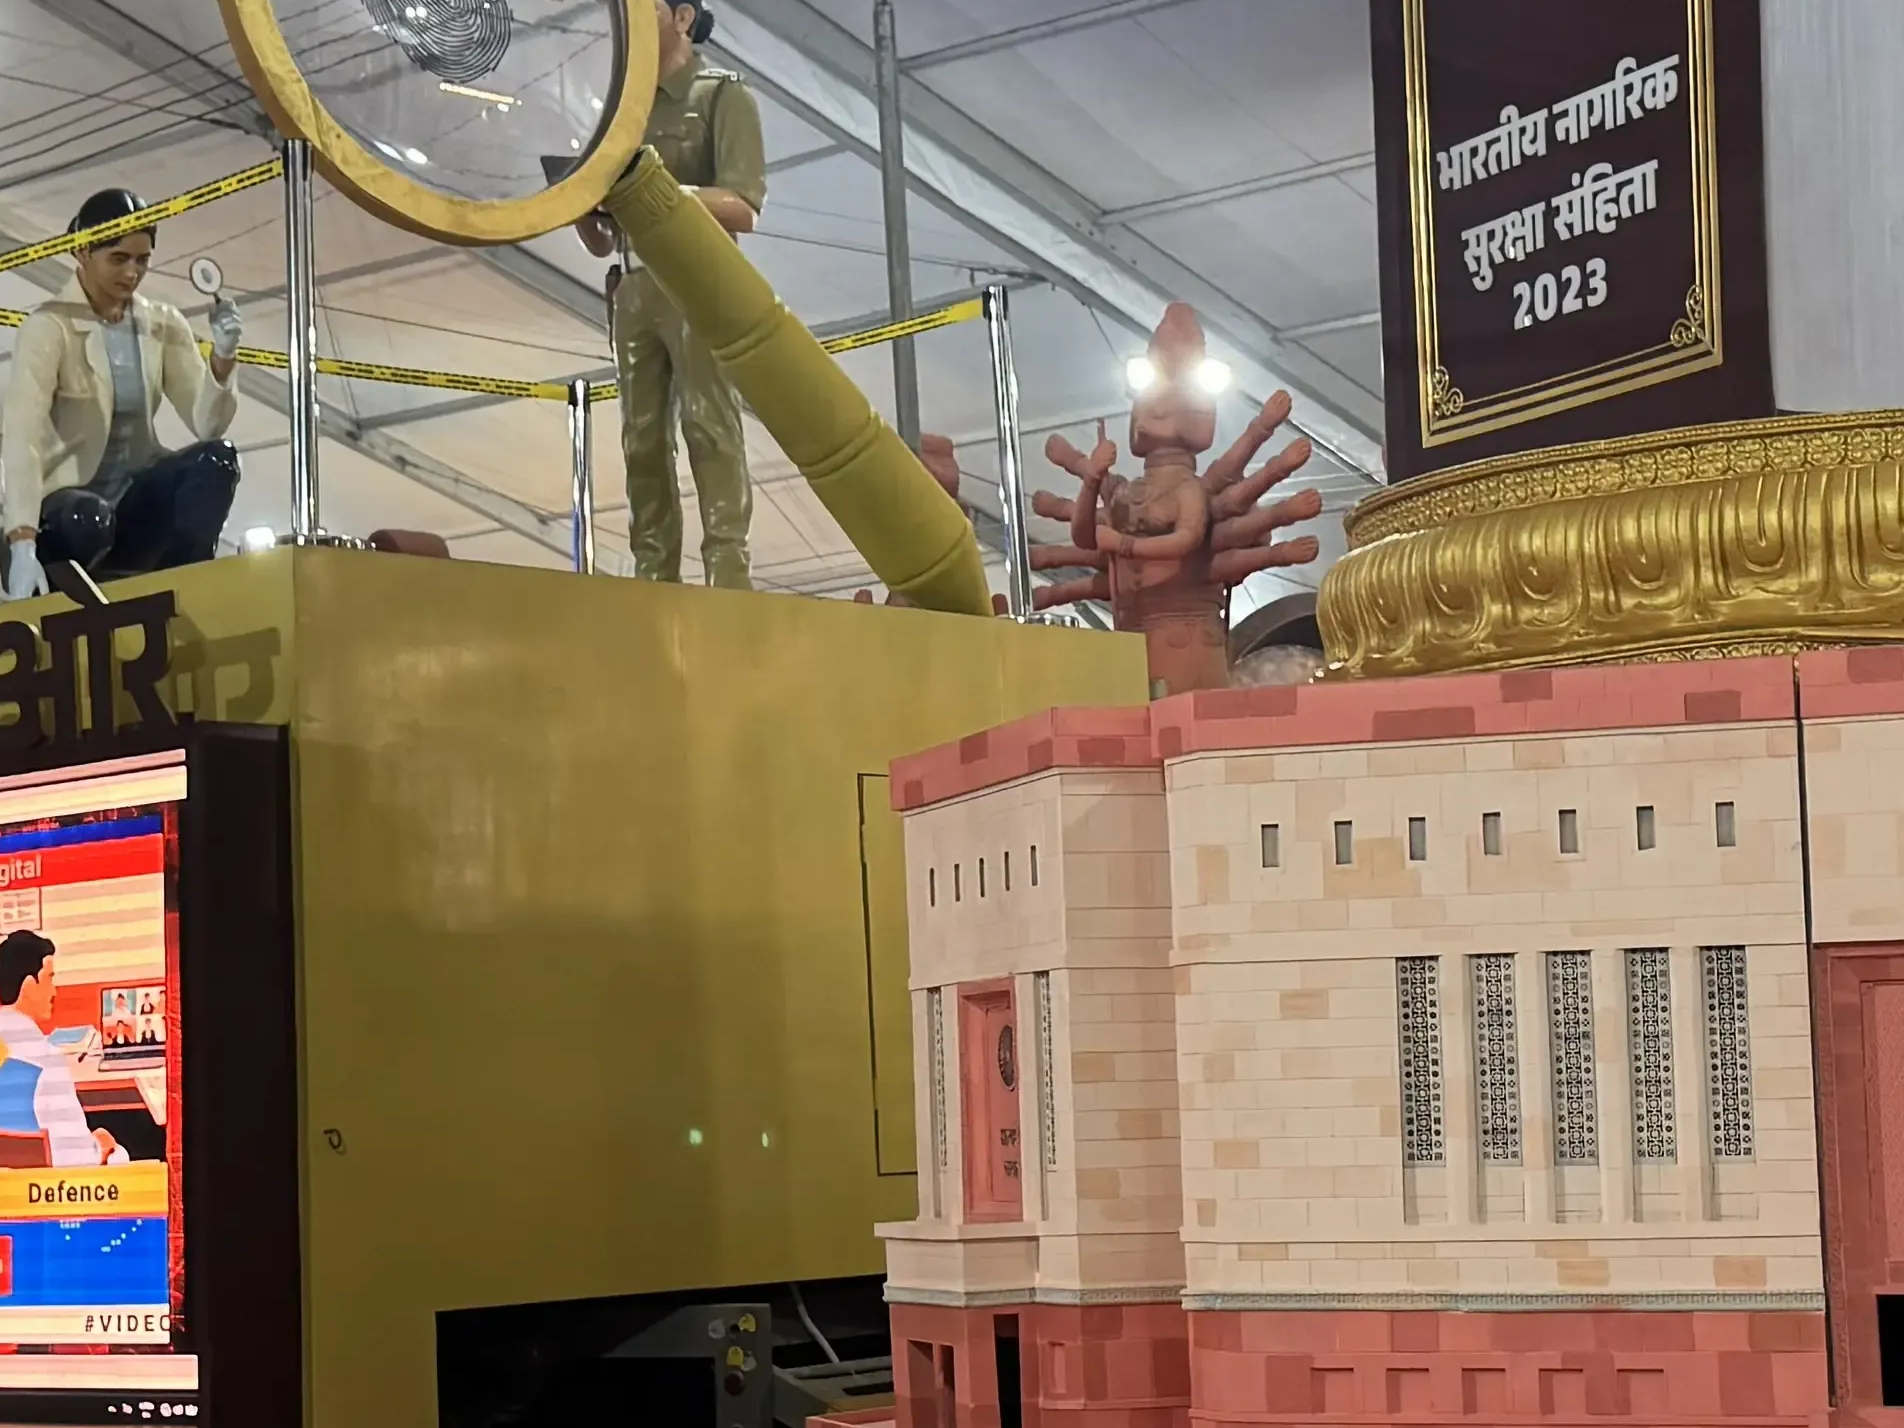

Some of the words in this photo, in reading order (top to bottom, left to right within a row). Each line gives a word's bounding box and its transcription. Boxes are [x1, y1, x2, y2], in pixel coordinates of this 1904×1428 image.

[1436, 105, 1549, 191] भारतीय
[1552, 54, 1680, 145] नागरिक
[1461, 201, 1546, 291] सुरक्षा
[1551, 159, 1659, 241] संहिता
[1512, 257, 1609, 331] 2023
[27, 1180, 121, 1205] Defence
